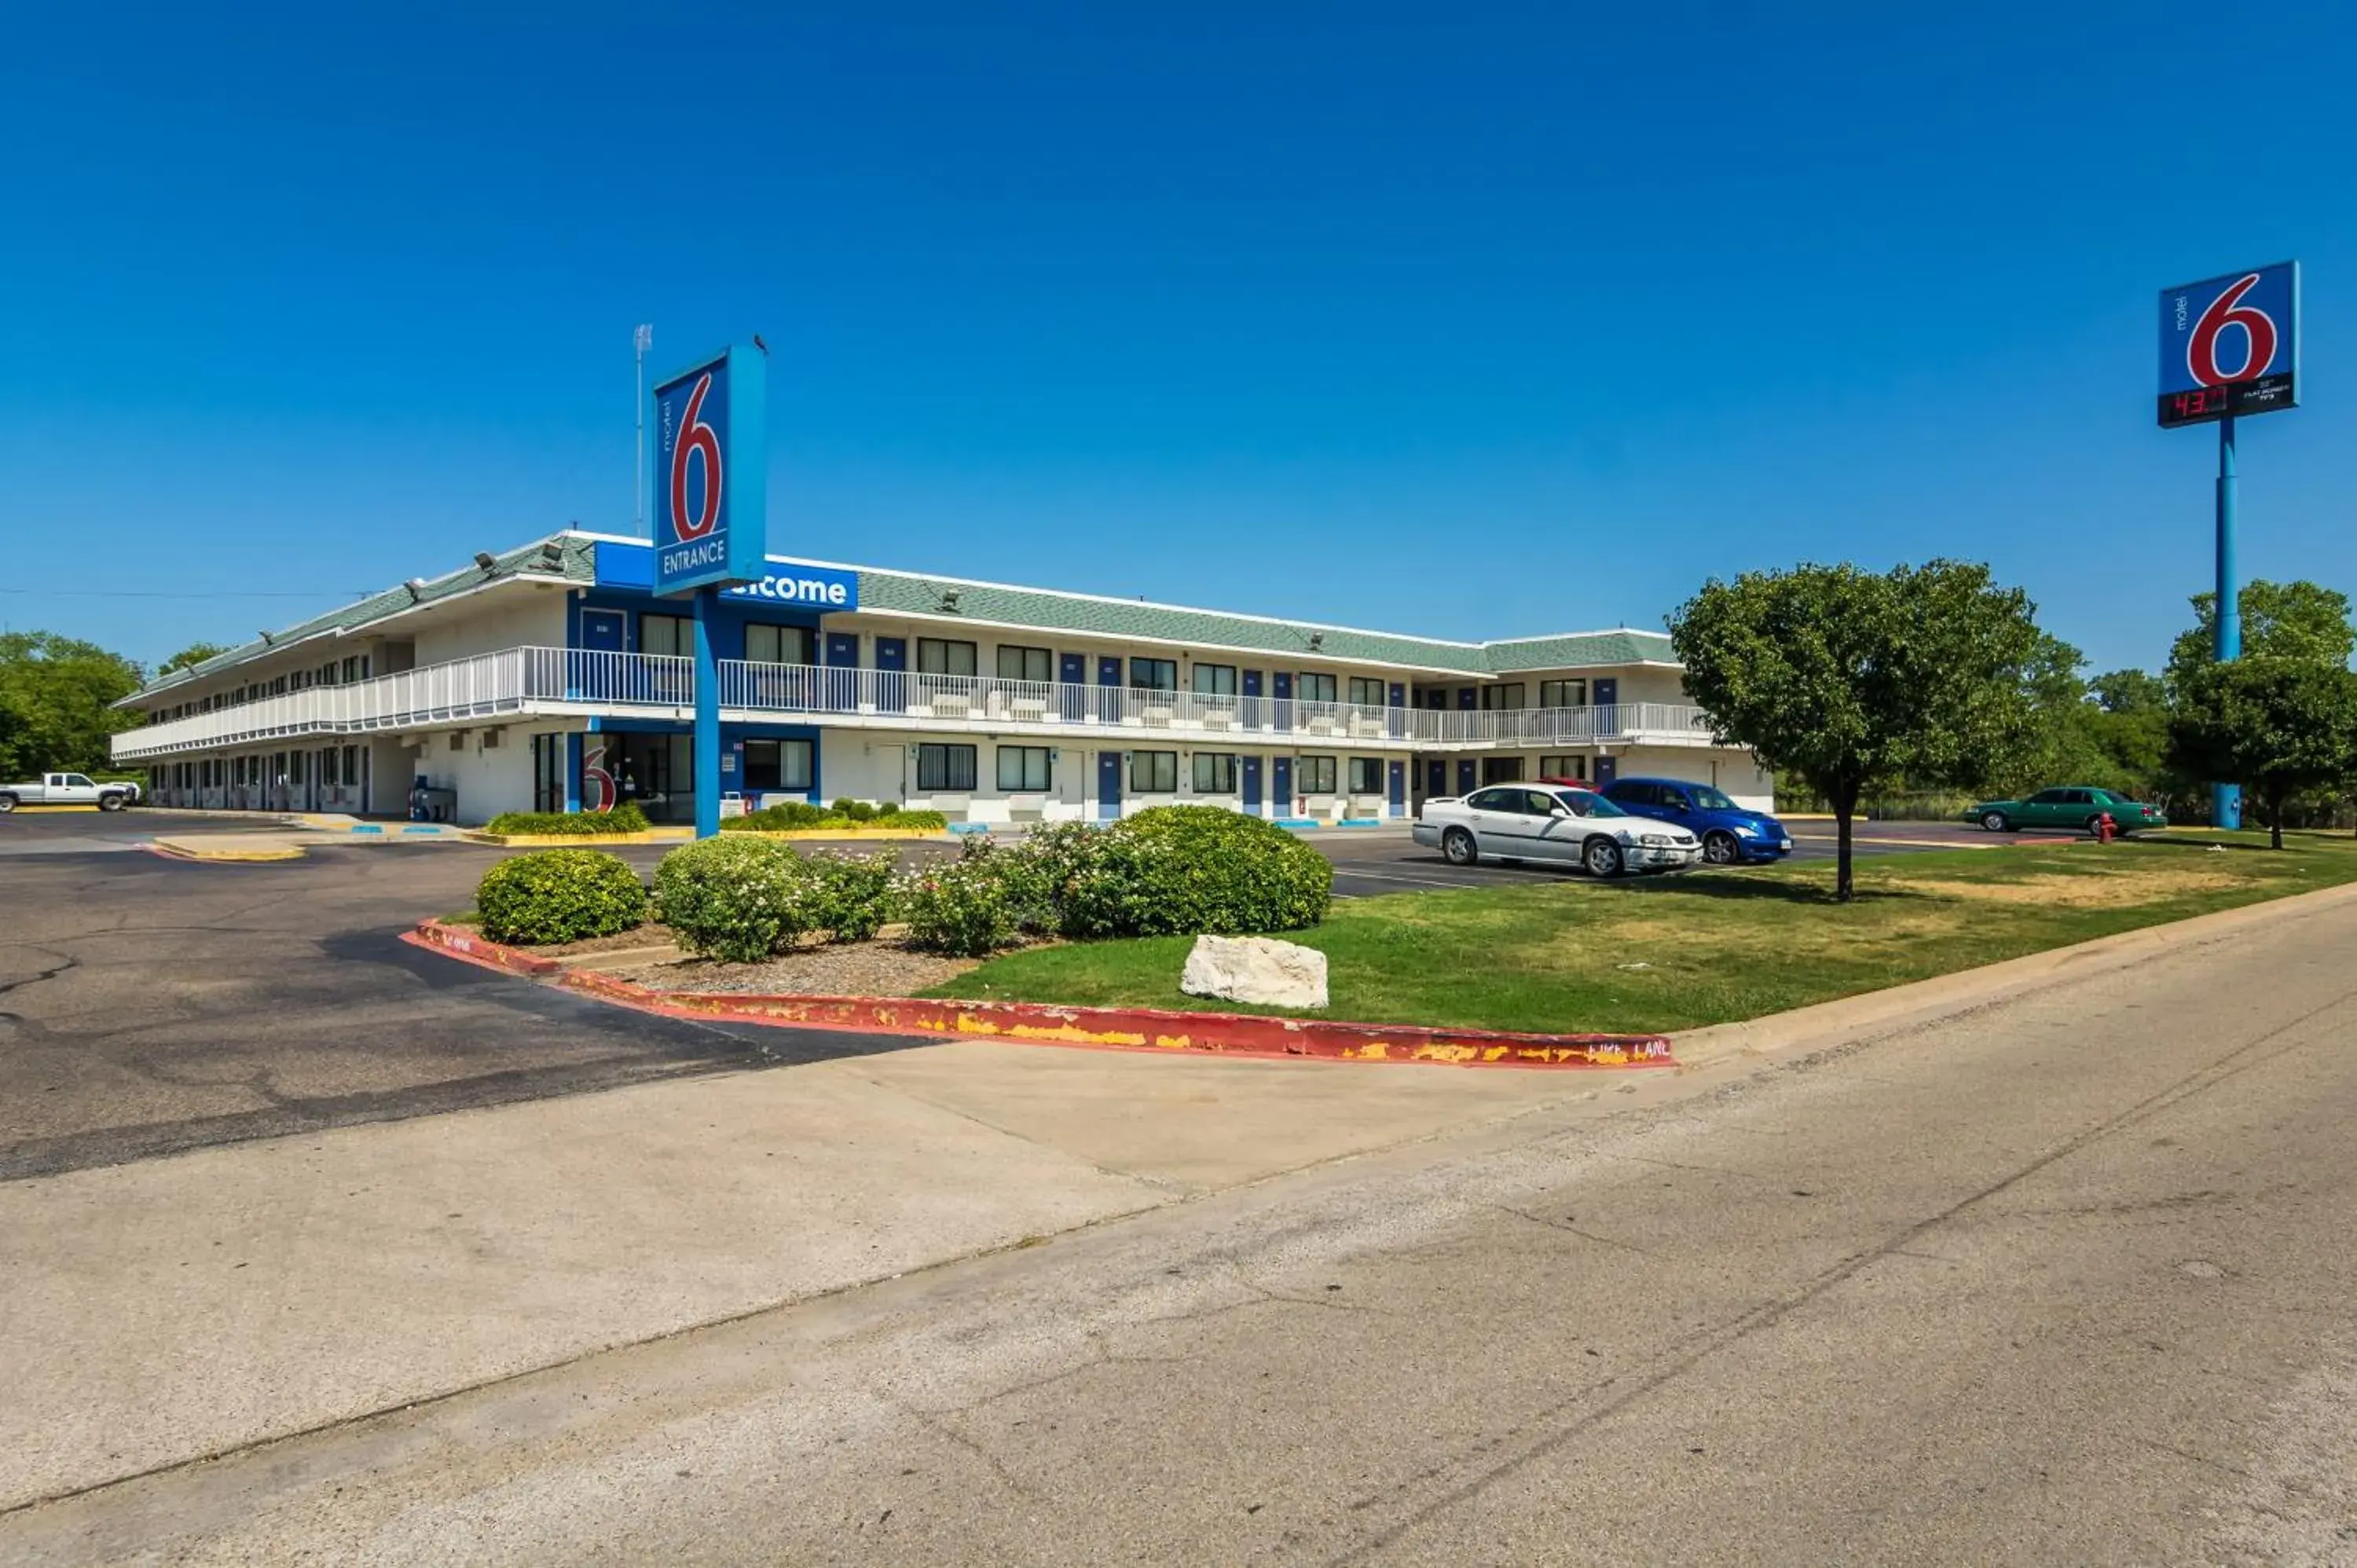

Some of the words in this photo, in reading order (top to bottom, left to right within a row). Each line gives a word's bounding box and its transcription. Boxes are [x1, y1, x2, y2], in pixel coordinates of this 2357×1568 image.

[2174, 295, 2187, 331] motel
[2187, 273, 2278, 388] 6
[670, 371, 723, 543] 6
[663, 540, 725, 575] ENTRANCE
[731, 574, 847, 604] come
